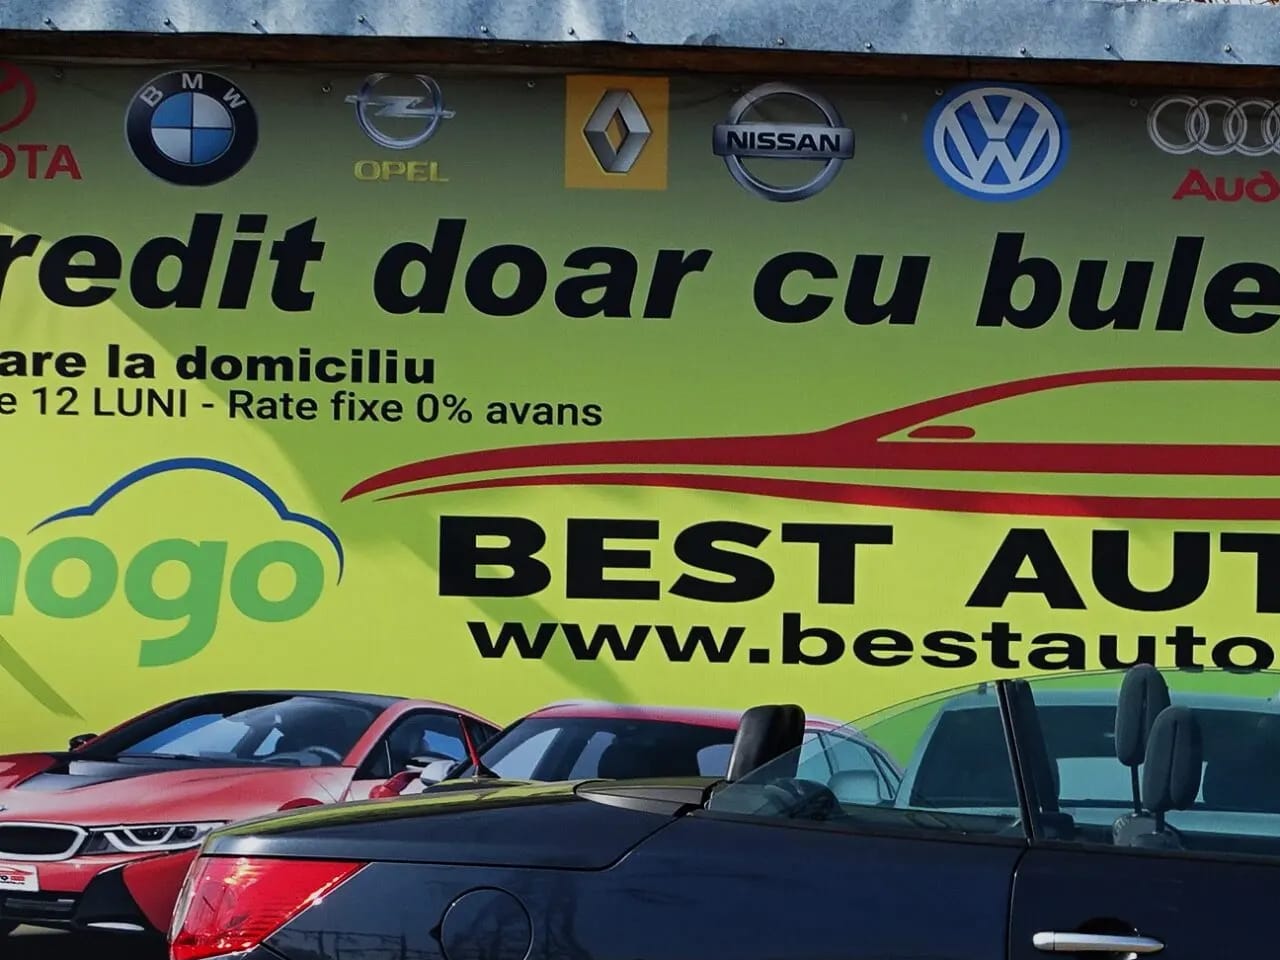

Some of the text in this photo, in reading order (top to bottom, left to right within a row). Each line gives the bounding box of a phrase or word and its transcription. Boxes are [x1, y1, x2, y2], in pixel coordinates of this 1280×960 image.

[726, 129, 841, 154] NISSAN
[354, 160, 449, 183] OPEL
[373, 218, 713, 318] doar
[753, 251, 931, 325] cu
[107, 344, 155, 380] la
[176, 346, 436, 385] domiciliu
[32, 386, 79, 416] 12
[94, 387, 187, 418] LUNI
[228, 391, 318, 421] Rate
[331, 392, 402, 422] fixe
[416, 394, 472, 424] 0%
[486, 401, 603, 428] avans
[439, 515, 893, 604] BEST
